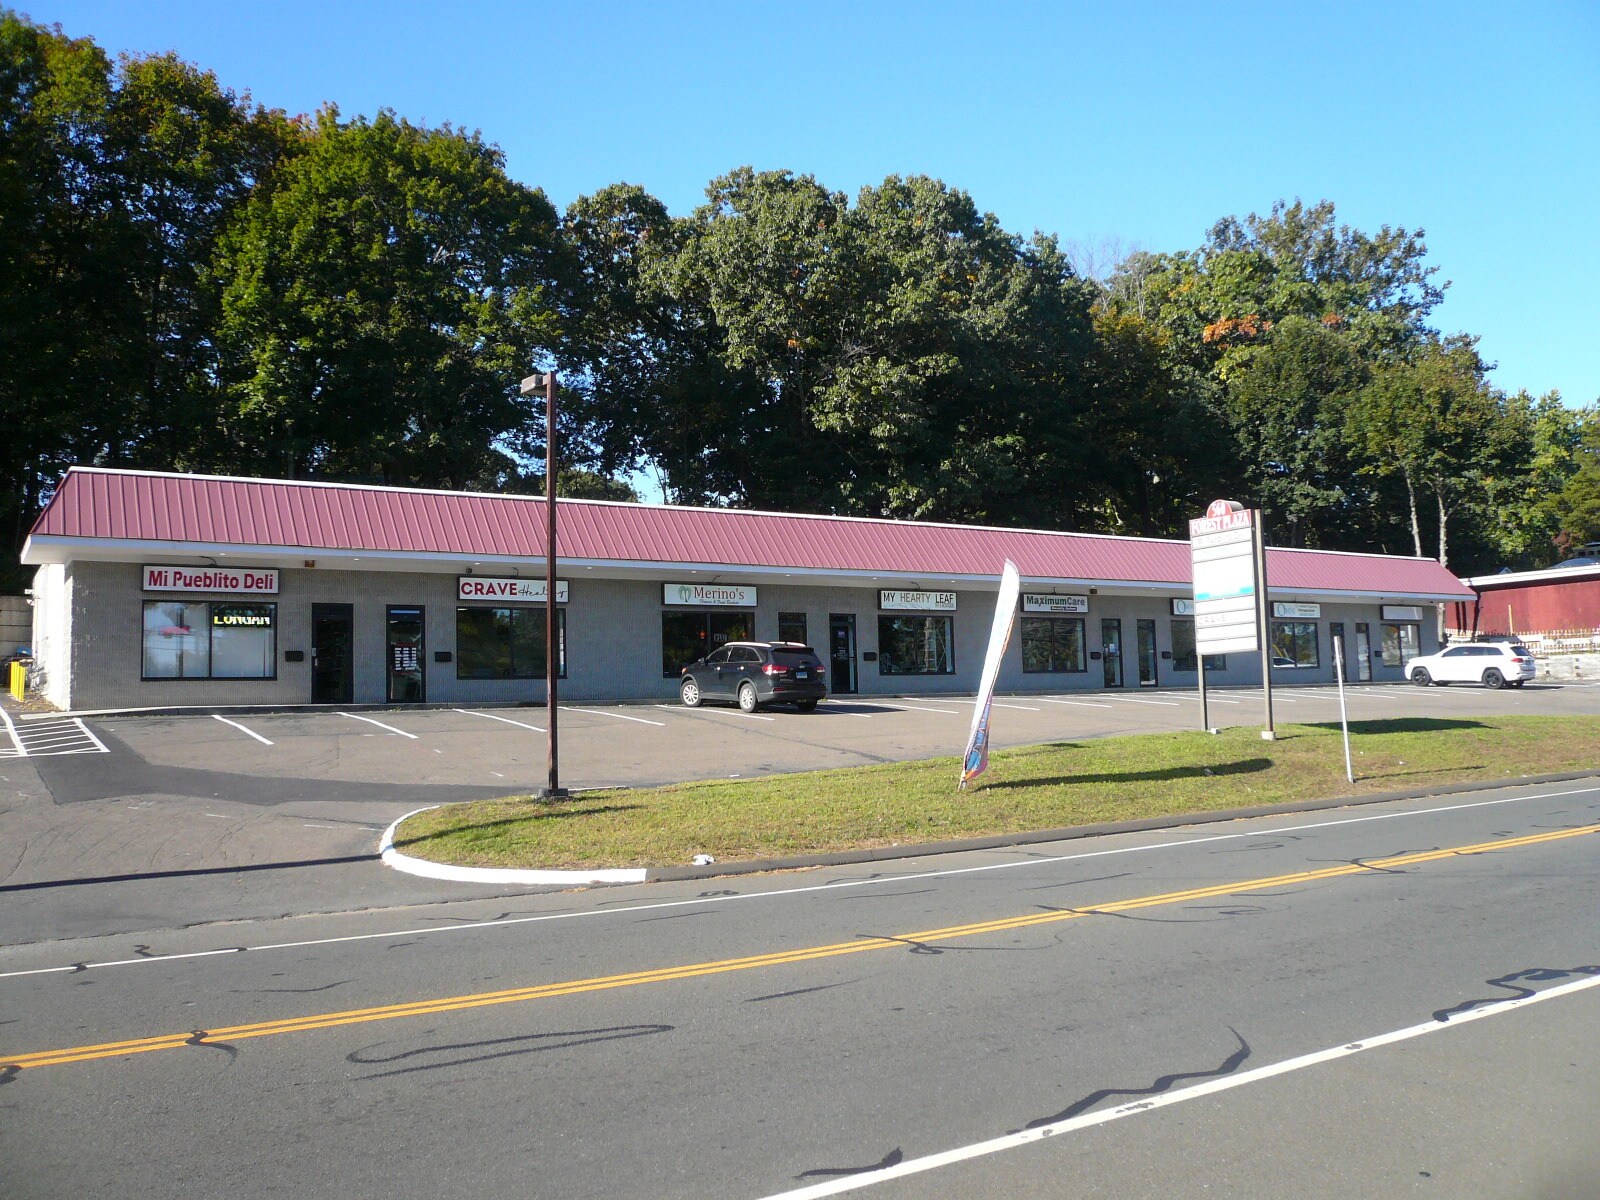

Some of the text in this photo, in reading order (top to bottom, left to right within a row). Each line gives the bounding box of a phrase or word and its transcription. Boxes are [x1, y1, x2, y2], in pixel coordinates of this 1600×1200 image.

[148, 570, 273, 590] Mi Pueblito Deli
[461, 582, 517, 595] CRAVE
[694, 587, 744, 600] Merino's
[883, 592, 954, 603] MY HEARTY LEAF
[1026, 596, 1085, 607] MaximumCare
